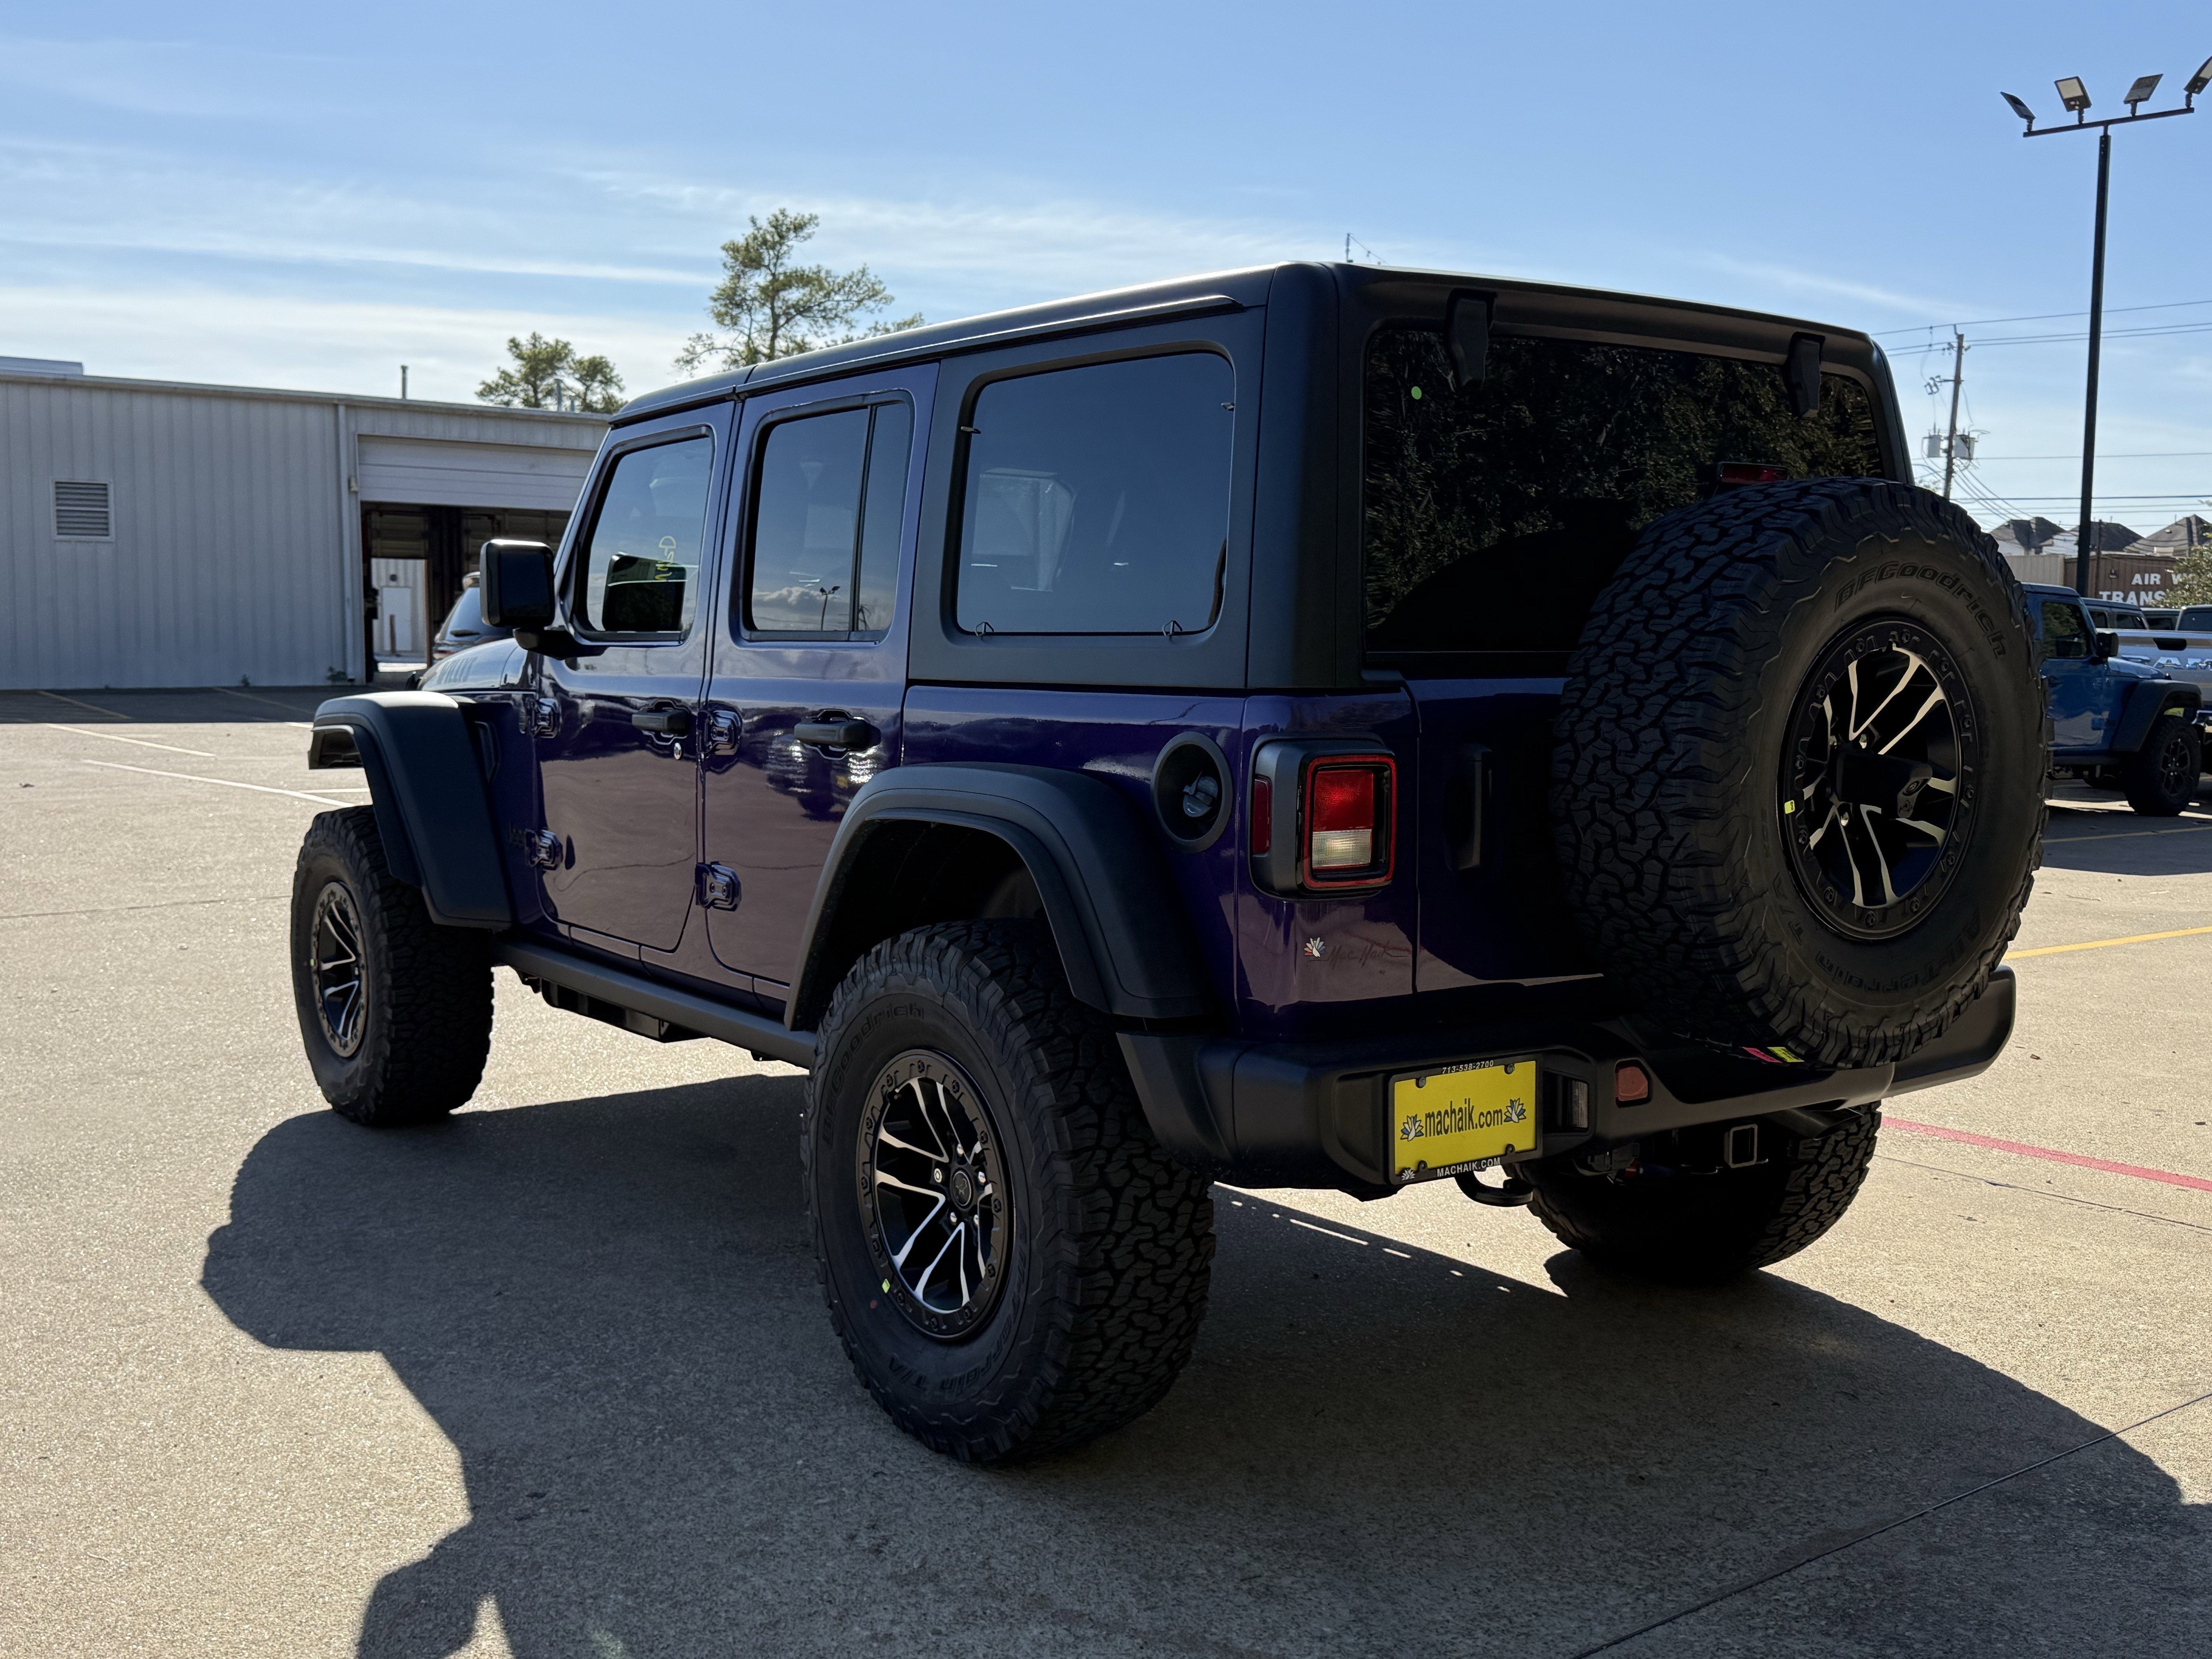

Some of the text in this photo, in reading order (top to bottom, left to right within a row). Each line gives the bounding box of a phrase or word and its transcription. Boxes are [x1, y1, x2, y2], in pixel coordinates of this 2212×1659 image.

[2131, 574, 2161, 585] AIR
[1834, 561, 2007, 659] BFGoodrich
[823, 1003, 924, 1147] BFGoodrich
[1442, 1060, 1494, 1074] 713-538-2700
[1425, 1098, 1503, 1138] machaik.com
[1437, 1157, 1501, 1177] MACHAIK.COM
